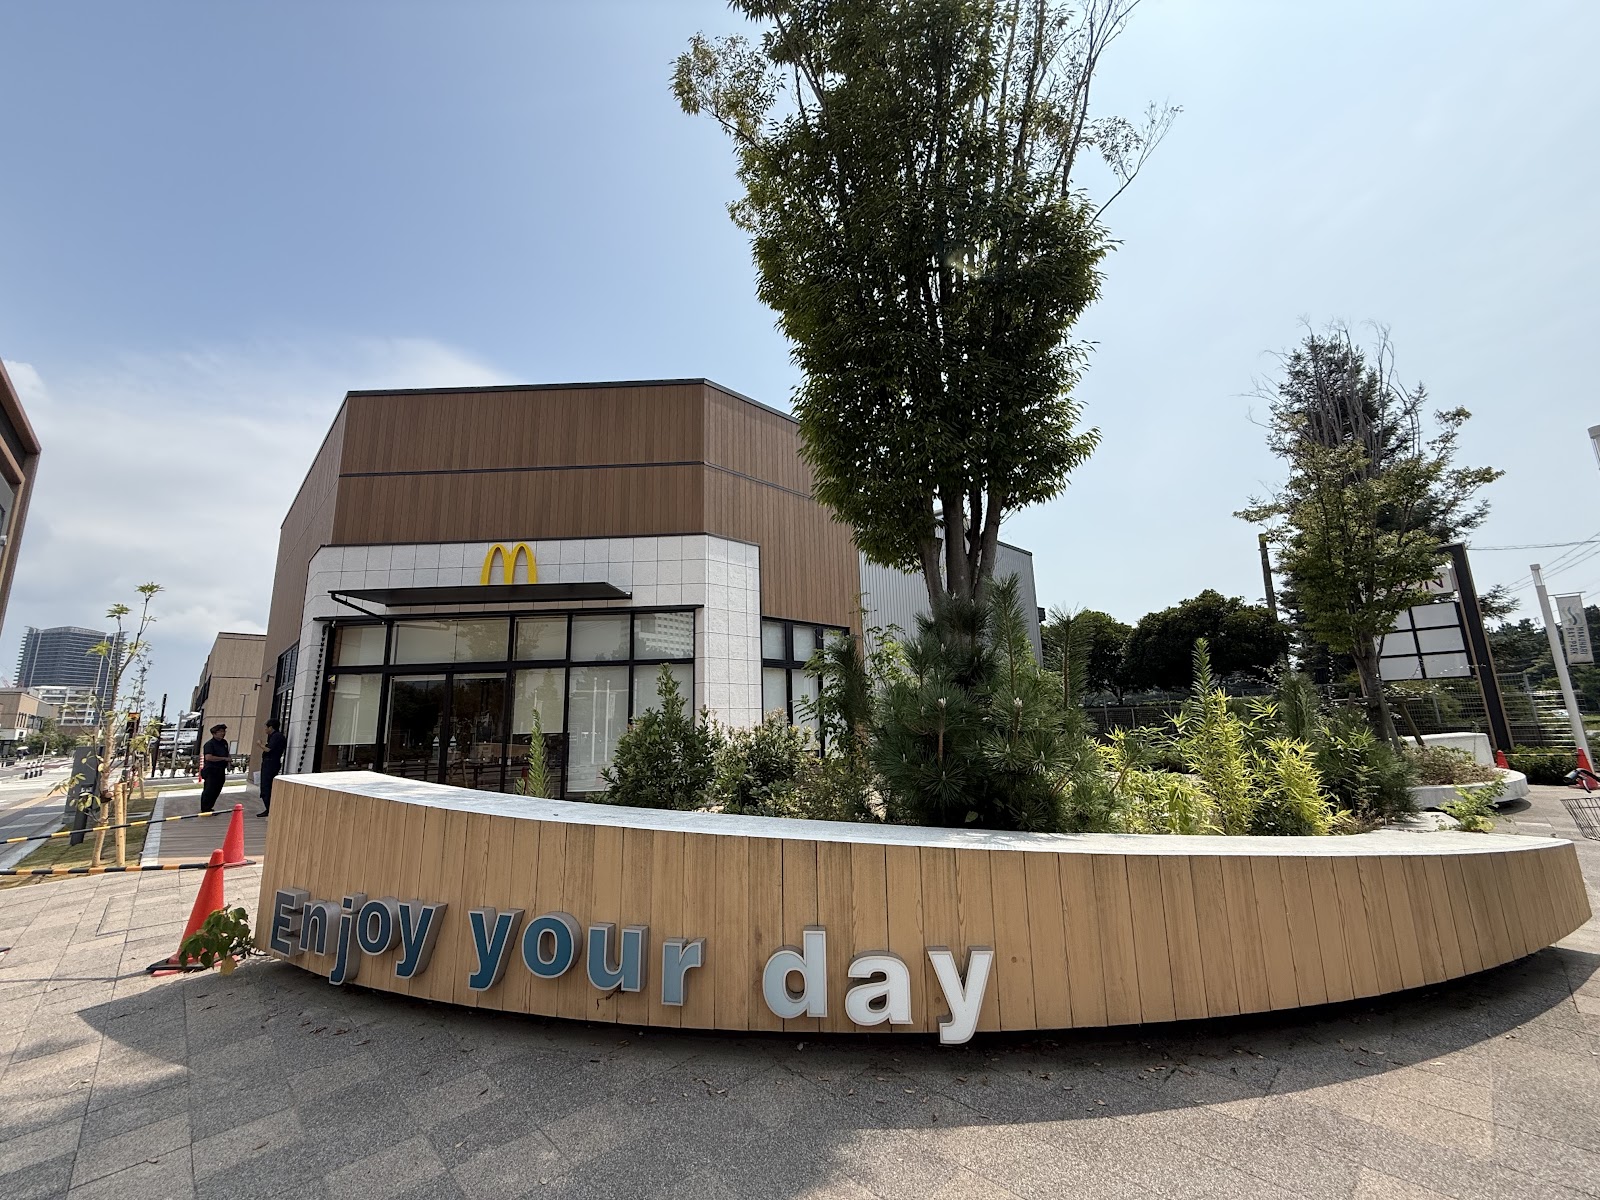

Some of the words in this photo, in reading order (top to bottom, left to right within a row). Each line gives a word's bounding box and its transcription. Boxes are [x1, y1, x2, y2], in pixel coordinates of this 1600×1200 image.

[1576, 626, 1588, 655] MAKUHARI
[270, 888, 447, 986] Enjoy
[468, 907, 705, 1006] your
[763, 925, 994, 1044] day
